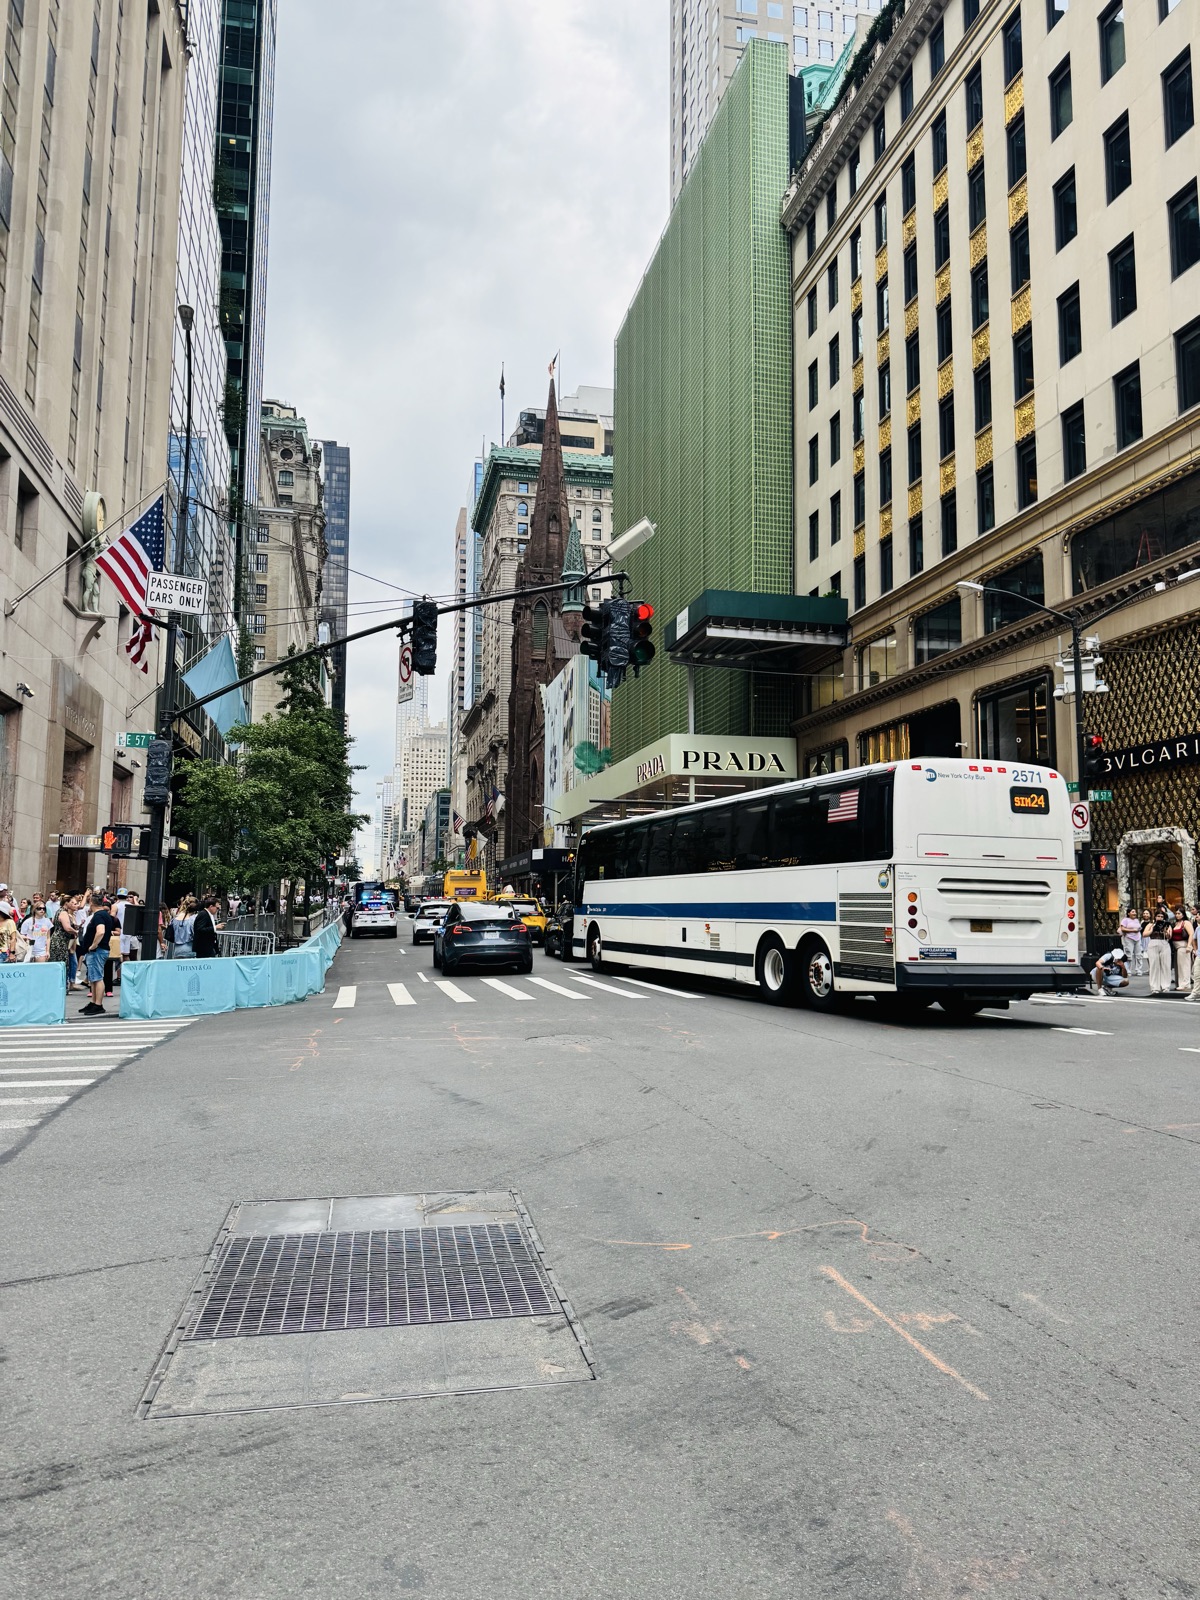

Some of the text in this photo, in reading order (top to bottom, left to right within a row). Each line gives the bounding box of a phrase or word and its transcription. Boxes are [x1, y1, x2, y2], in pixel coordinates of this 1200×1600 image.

[151, 577, 203, 595] PASSENGER
[150, 591, 202, 608] CARS ONLY
[126, 735, 131, 745] E
[135, 735, 145, 746] 57
[636, 754, 665, 783] PRADA
[682, 750, 786, 773] PRADA
[1012, 770, 1042, 783] 2571
[1014, 794, 1045, 808] SIM24
